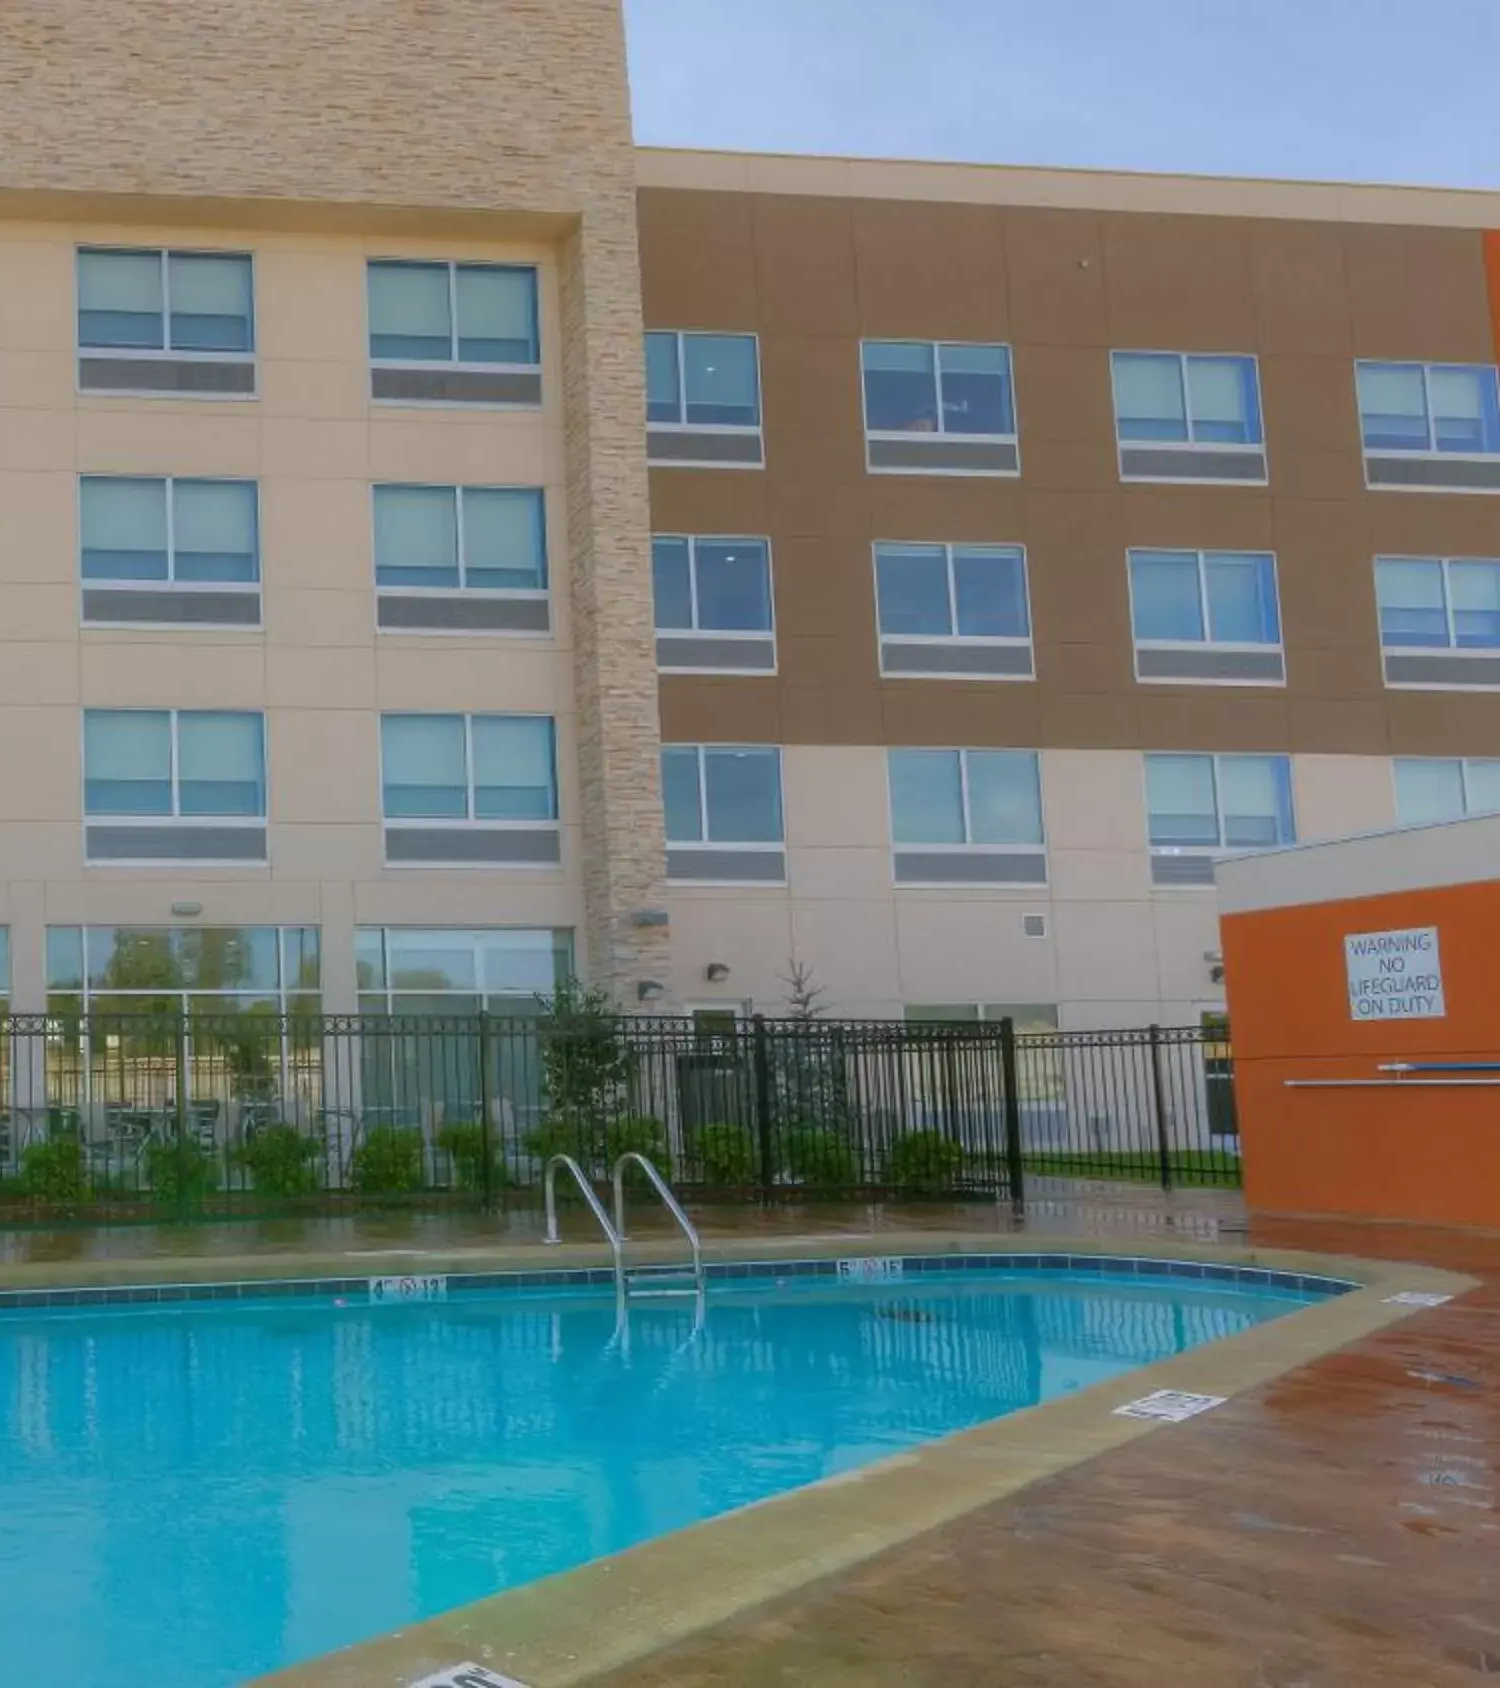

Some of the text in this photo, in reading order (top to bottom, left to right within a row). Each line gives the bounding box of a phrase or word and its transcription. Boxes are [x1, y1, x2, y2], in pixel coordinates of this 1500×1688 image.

[1351, 934, 1432, 956] WARNING
[1379, 957, 1405, 973] NO
[1351, 975, 1440, 997] LIFEGUARD
[1358, 996, 1435, 1015] ON DUTY
